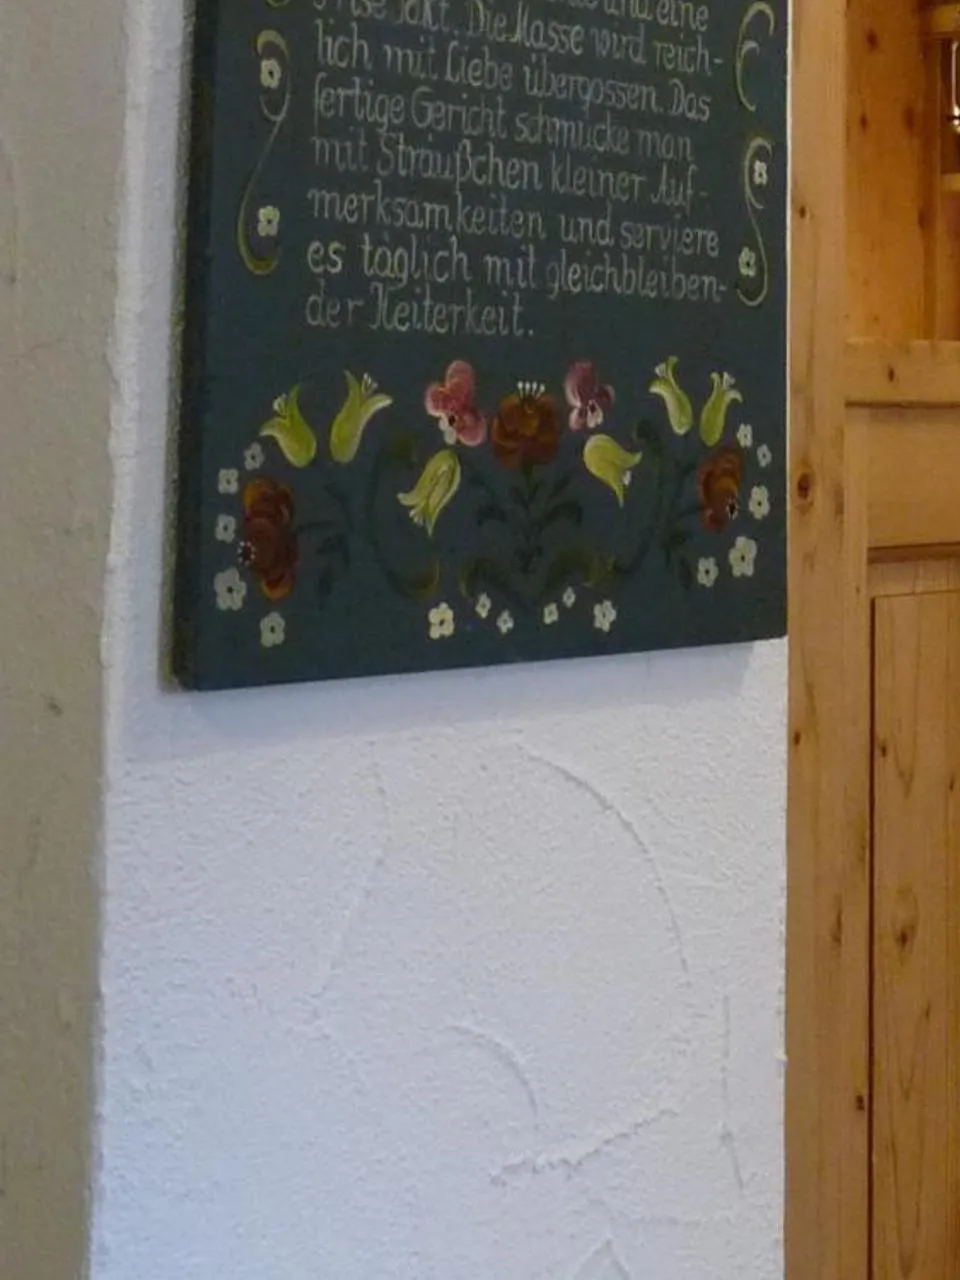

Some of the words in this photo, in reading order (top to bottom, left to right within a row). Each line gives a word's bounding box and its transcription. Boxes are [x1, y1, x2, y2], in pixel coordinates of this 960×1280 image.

[314, 17, 374, 72] lich
[382, 34, 439, 81] mit
[444, 39, 514, 92] Liebe
[667, 77, 713, 123] Das
[507, 1, 584, 56] Masse
[589, 21, 647, 66] wird
[312, 70, 405, 136] fertige
[410, 84, 509, 141] Gericht
[636, 128, 696, 162] man
[309, 124, 370, 173] mit
[549, 150, 649, 203] kleiner
[305, 178, 548, 241] merksamkeiten
[557, 200, 615, 248] und
[620, 213, 721, 259] serviere
[304, 278, 365, 329] der
[305, 239, 347, 275] es
[482, 242, 537, 290] mit
[544, 247, 729, 303] gleichbleiben-
